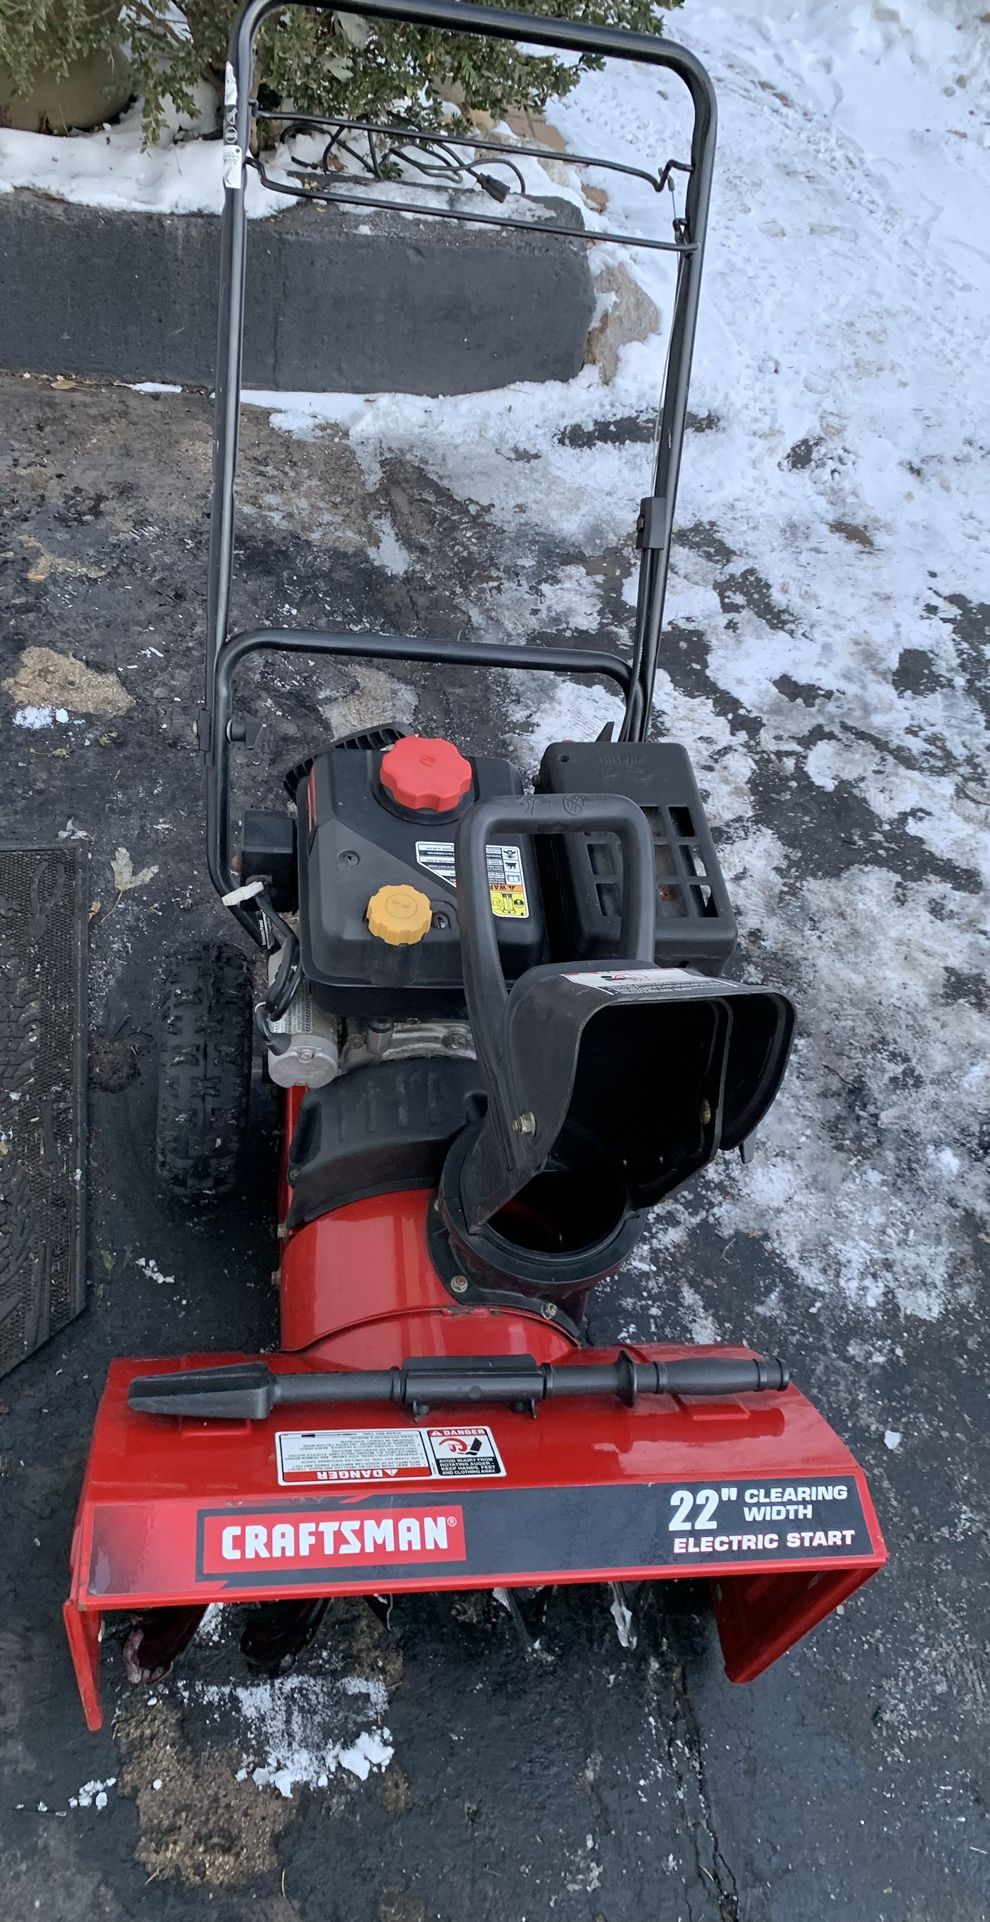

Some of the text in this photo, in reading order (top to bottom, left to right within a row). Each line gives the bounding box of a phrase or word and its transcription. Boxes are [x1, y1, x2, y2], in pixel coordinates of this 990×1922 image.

[316, 1469, 384, 1480] DANGER
[668, 1485, 848, 1531] 22" CLEARING
[743, 1504, 812, 1522] WIDTH
[673, 1530, 856, 1554] ELECTRIC START
